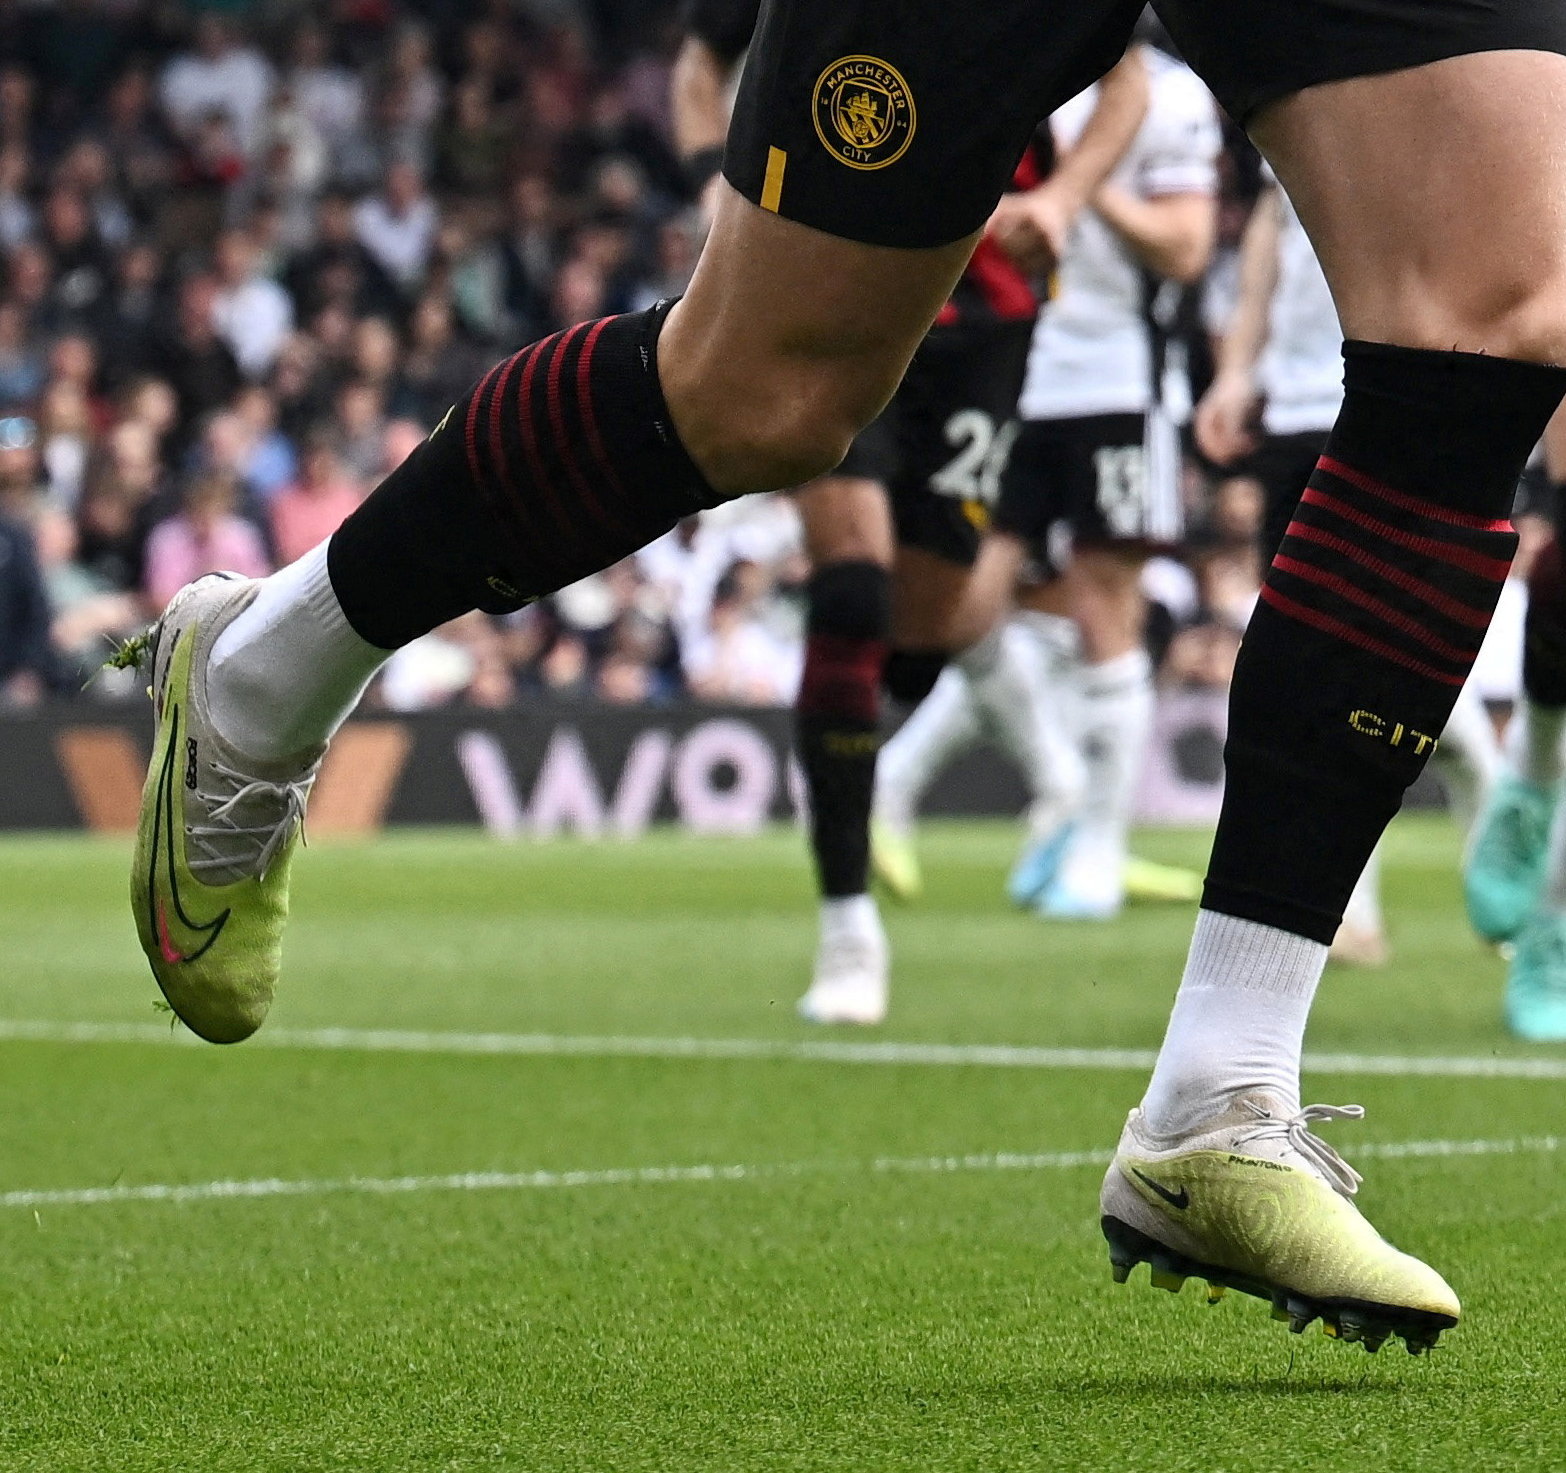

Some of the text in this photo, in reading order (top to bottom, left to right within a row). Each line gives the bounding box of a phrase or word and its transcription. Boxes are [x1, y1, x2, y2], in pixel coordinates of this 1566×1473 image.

[826, 64, 906, 109] MANCHESTER
[842, 145, 871, 162] CITY
[1348, 709, 1438, 755] CIT
